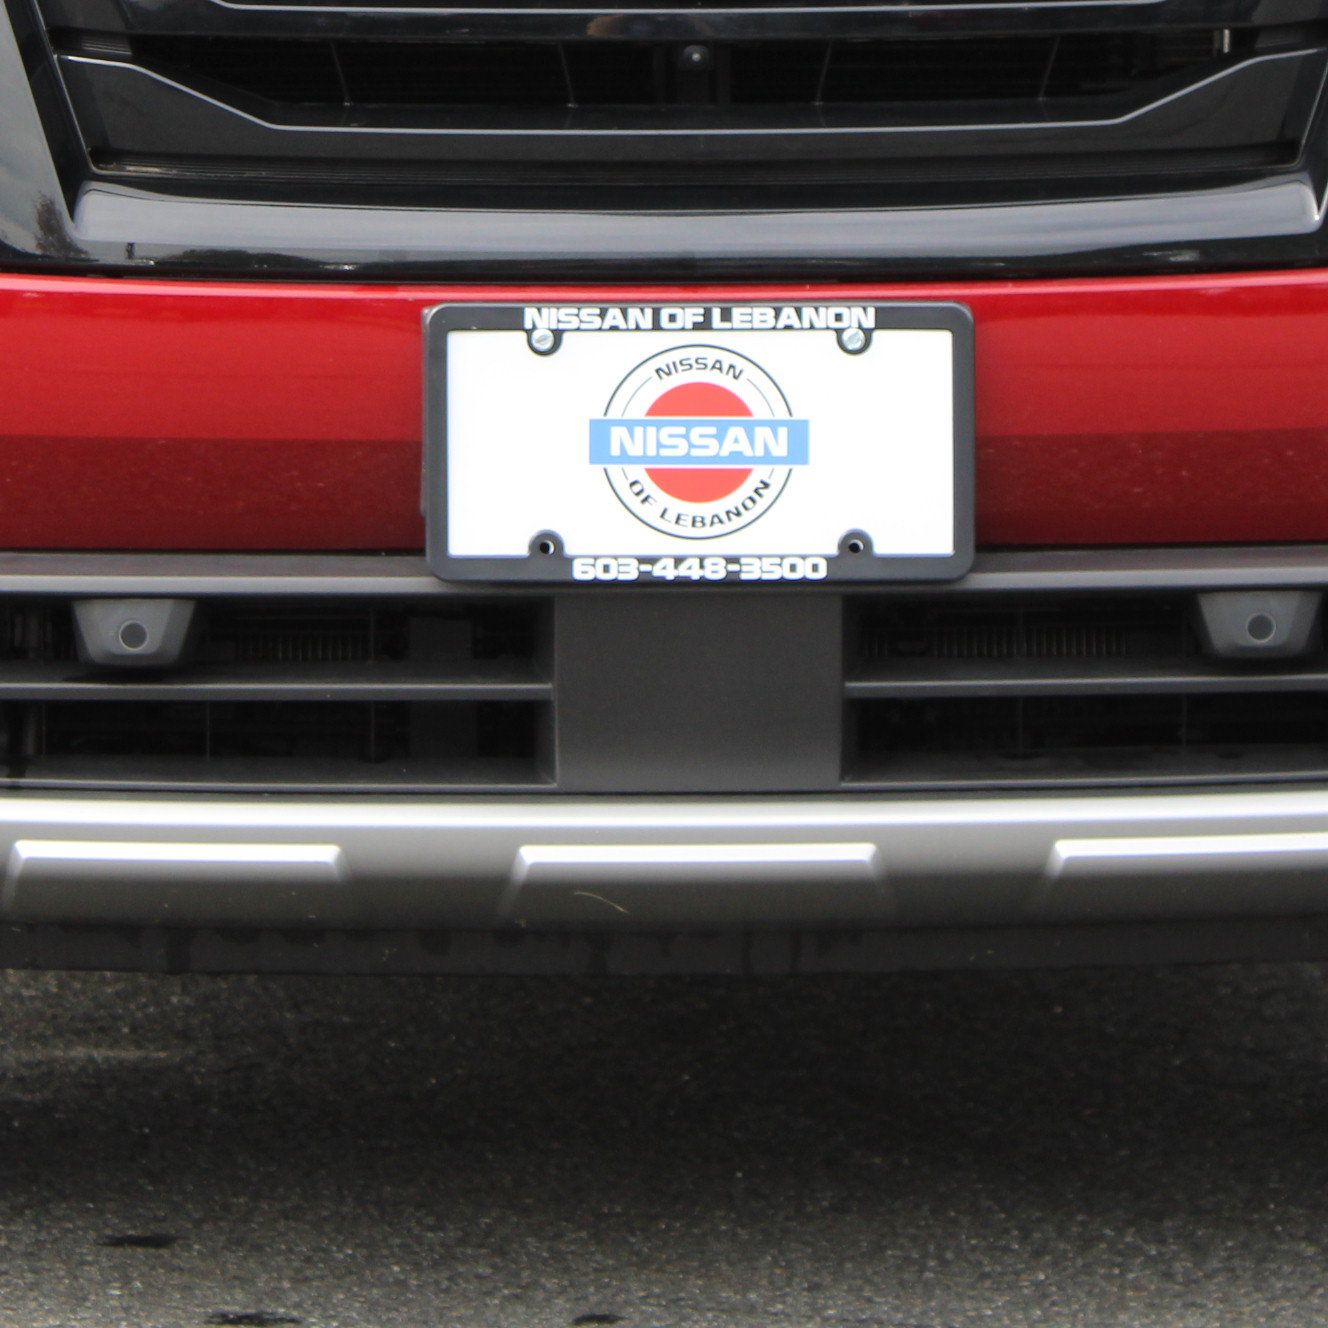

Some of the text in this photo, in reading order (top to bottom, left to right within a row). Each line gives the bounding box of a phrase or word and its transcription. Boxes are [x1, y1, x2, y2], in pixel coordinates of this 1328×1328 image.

[523, 306, 876, 330] NISSAN OF LEBANON
[654, 356, 744, 381] NISSAN
[609, 426, 789, 457] NISSAN
[628, 478, 771, 529] OF LEBANON
[572, 556, 828, 581] 603-448-3500
